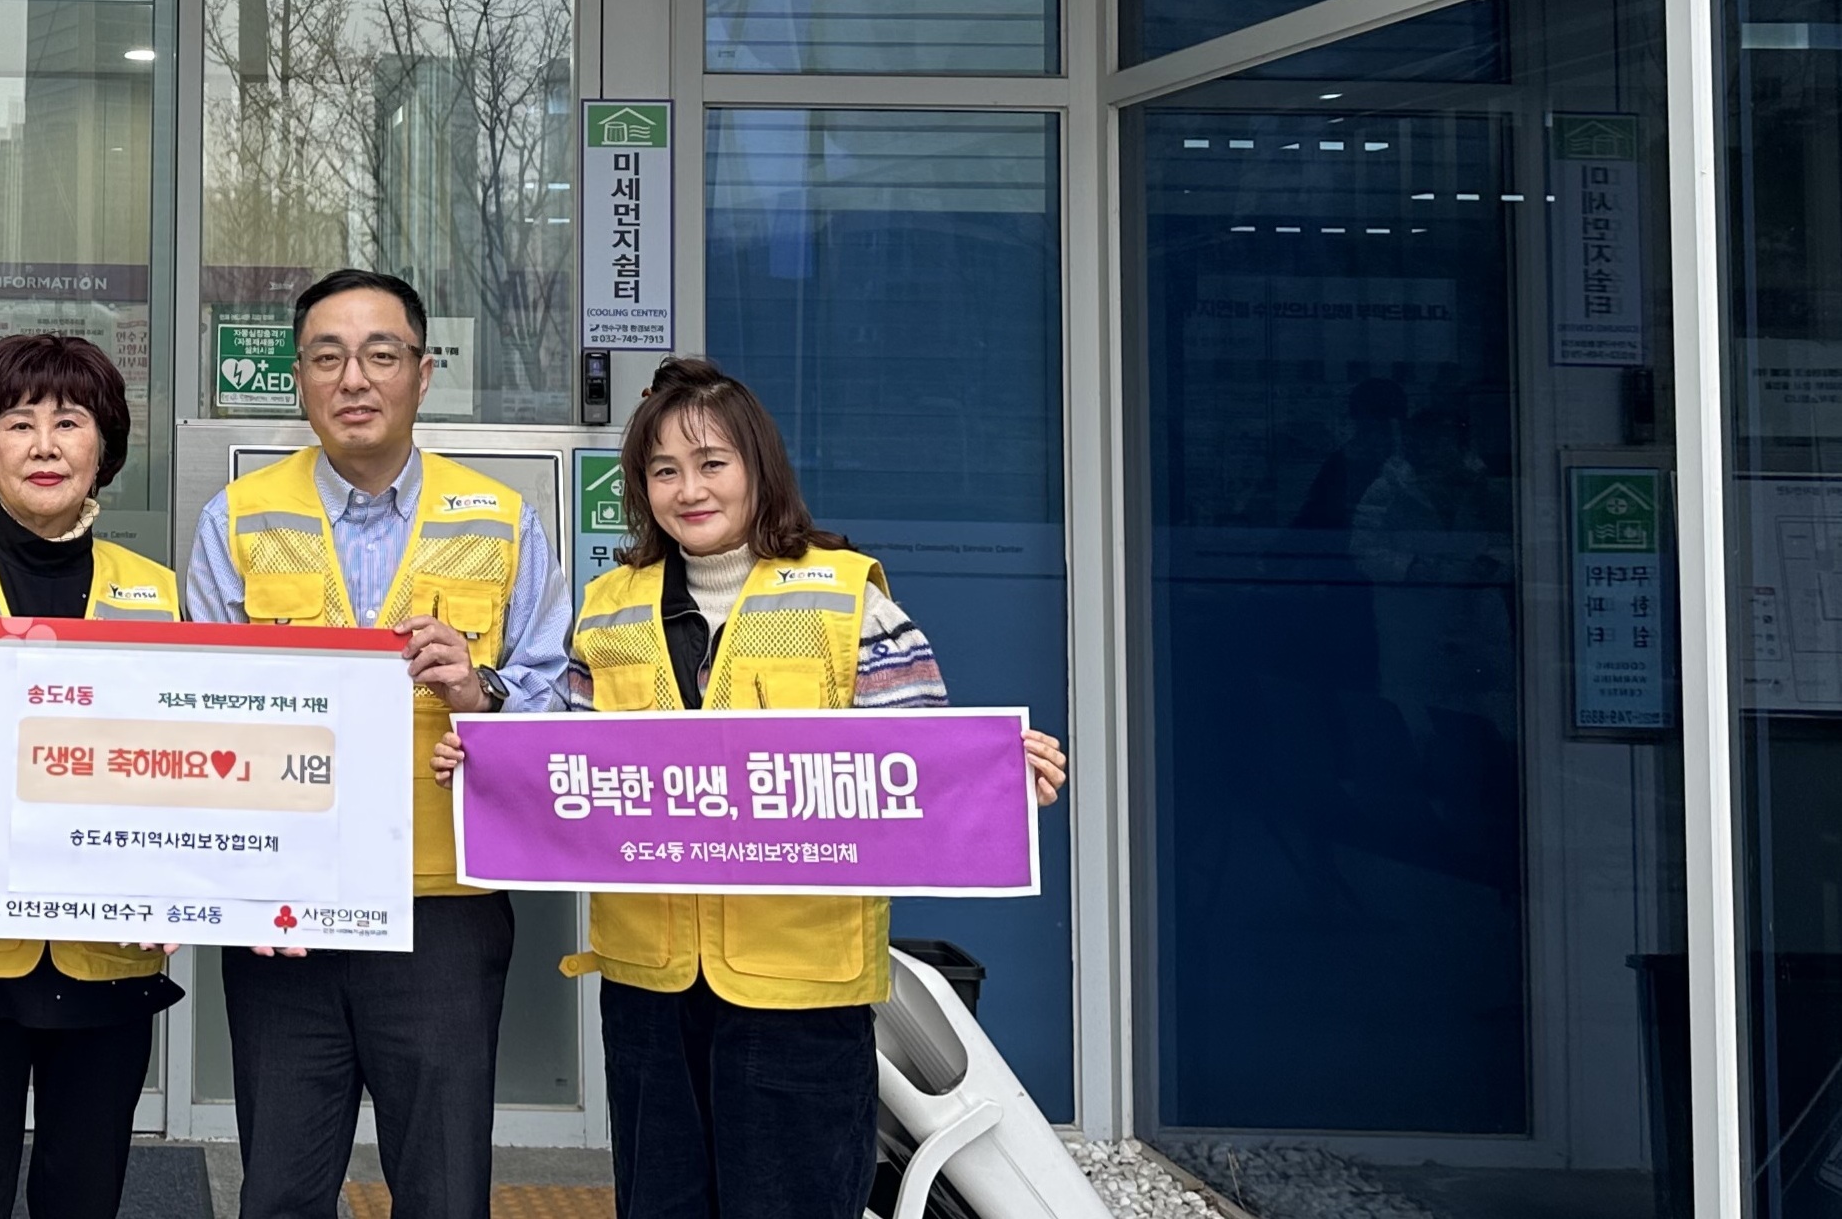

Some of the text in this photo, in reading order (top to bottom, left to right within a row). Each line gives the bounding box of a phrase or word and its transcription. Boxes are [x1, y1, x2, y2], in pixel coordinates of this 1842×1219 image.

[611, 152, 640, 303] 미세먼지쉼터
[587, 308, 668, 319] (COOLING CENTER)
[251, 372, 295, 392] AED
[28, 685, 94, 706] 송도4동
[158, 691, 197, 709] 저소득
[201, 693, 265, 711] 한부모가정
[270, 696, 297, 712] 자녀
[281, 754, 331, 784] 사업
[547, 752, 923, 820] 행복한 인생, 함께해요
[70, 829, 279, 853] 송도4동지역사회보장협의체
[620, 841, 858, 863] 송도4동 지역사회보장협의체
[6, 900, 223, 925] 인천광역시 연수구 송도4동
[301, 907, 388, 928] 사랑의열매
